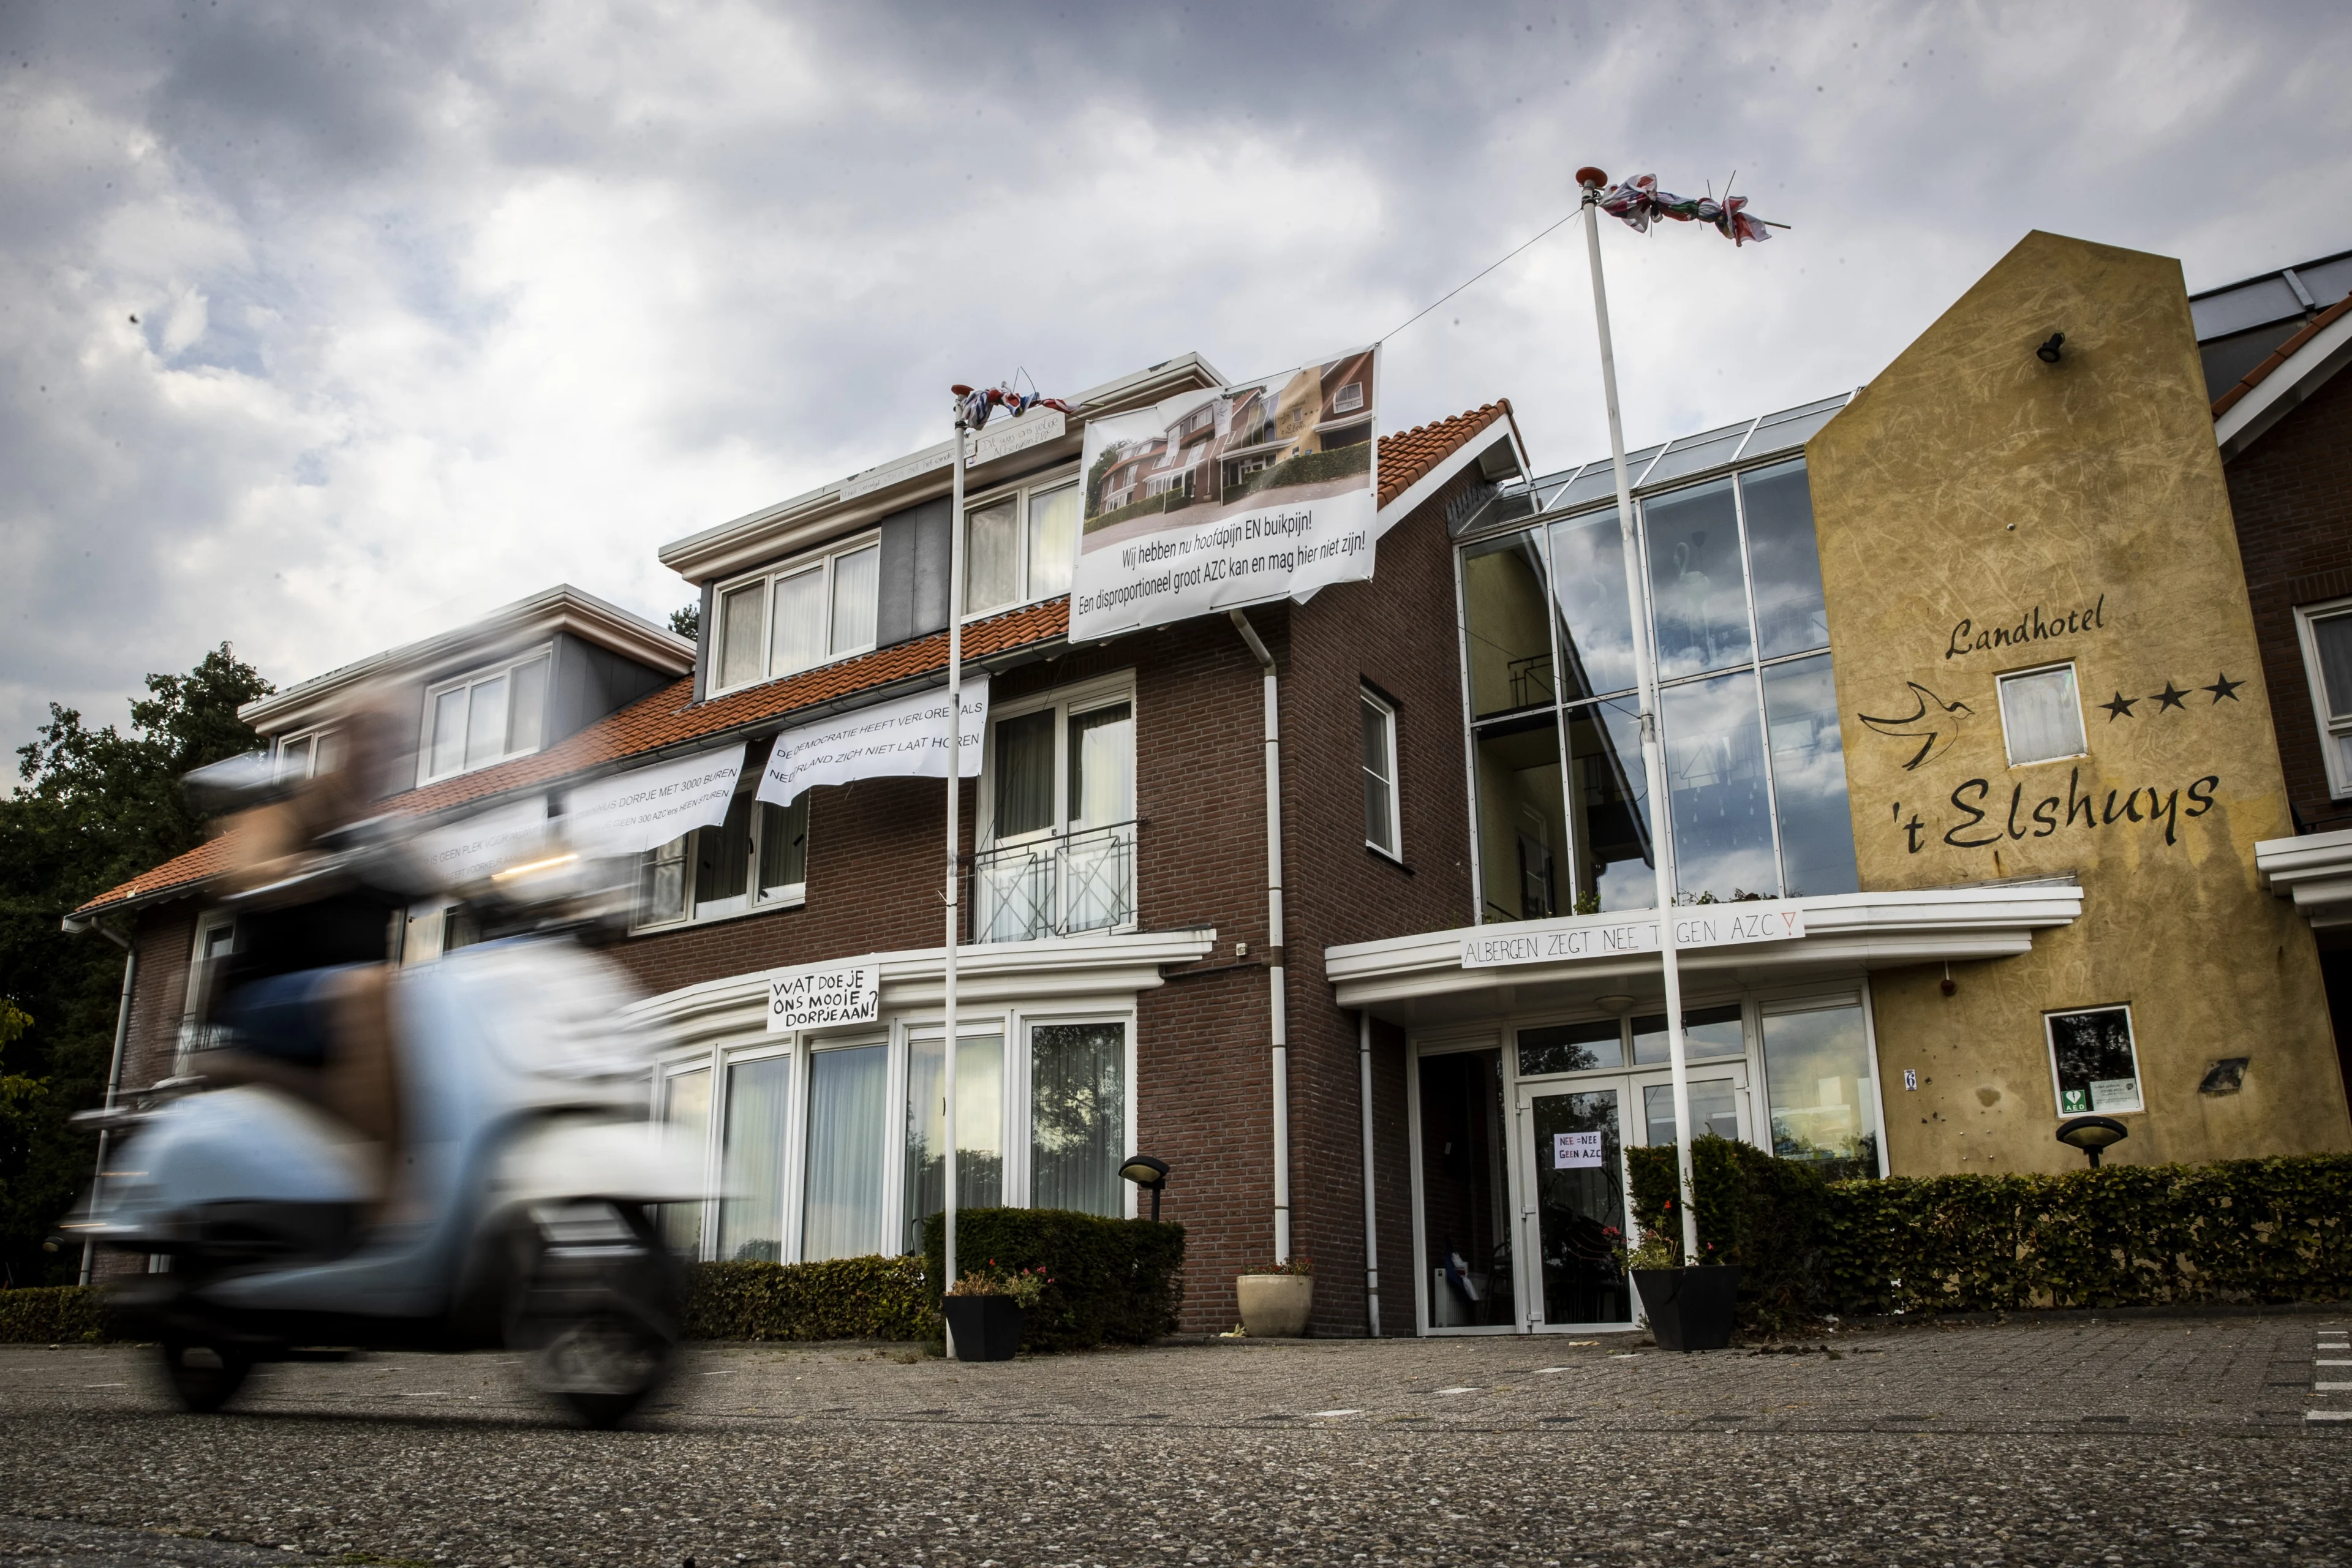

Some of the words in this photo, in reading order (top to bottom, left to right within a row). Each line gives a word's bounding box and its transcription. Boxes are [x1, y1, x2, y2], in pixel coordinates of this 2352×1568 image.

[1000, 435, 1015, 445] was
[1018, 427, 1033, 439] ons
[1123, 546, 1136, 571] Wij
[1139, 540, 1176, 564] hebben
[1179, 540, 1192, 555] nu
[1194, 524, 1242, 551] hoofdpijn
[1245, 518, 1261, 540] EN
[1264, 510, 1312, 538] buikpijn!
[1079, 596, 1094, 616] Een
[1096, 570, 1171, 611] disproportioneel
[1174, 565, 1200, 594] groot
[1204, 559, 1226, 582] AZC
[1229, 557, 1248, 578] kan
[1252, 556, 1265, 573] en
[1268, 551, 1294, 573] mag
[1297, 545, 1318, 567] hier
[1320, 537, 1340, 560] niet
[1341, 530, 1365, 557] zijn!
[1945, 594, 2105, 660] Landhotel
[777, 749, 793, 760] DE
[794, 728, 858, 755] DEMOCRATIE
[859, 719, 895, 734] HEEFT
[899, 707, 949, 726] VERLORE
[960, 703, 982, 715] ALS
[770, 755, 832, 783] NEDERLAND
[835, 748, 862, 763] ZICH
[865, 744, 895, 755] NIET
[897, 737, 929, 752] LAAT
[619, 790, 657, 808] DORPJE
[659, 783, 679, 798] MET
[681, 777, 702, 792] 3000
[703, 768, 737, 785] BUREN
[613, 816, 636, 827] GEEN
[638, 814, 651, 824] 300
[652, 808, 678, 821] AZC'ers
[679, 798, 698, 813] HEEN
[698, 790, 729, 804] STUREN
[1893, 801, 1925, 854] 't
[1943, 766, 2220, 847] Elshuys
[431, 854, 437, 866] IS
[439, 847, 461, 863] GEEN
[462, 842, 483, 856] PLEK
[467, 857, 502, 874] VOORKEUR
[1464, 937, 1539, 963] ALBERGEN
[1548, 931, 1591, 956] ZEGT
[1603, 927, 1639, 951] NEE
[1649, 919, 1716, 945] TGEN
[773, 975, 815, 997] WAT
[819, 974, 843, 990] DOE
[774, 996, 803, 1014] ONS
[1906, 1072, 1915, 1088] 6
[1559, 1136, 1574, 1146] NEE
[1559, 1150, 1579, 1159] GEEN
[1582, 1149, 1602, 1158] AZC
